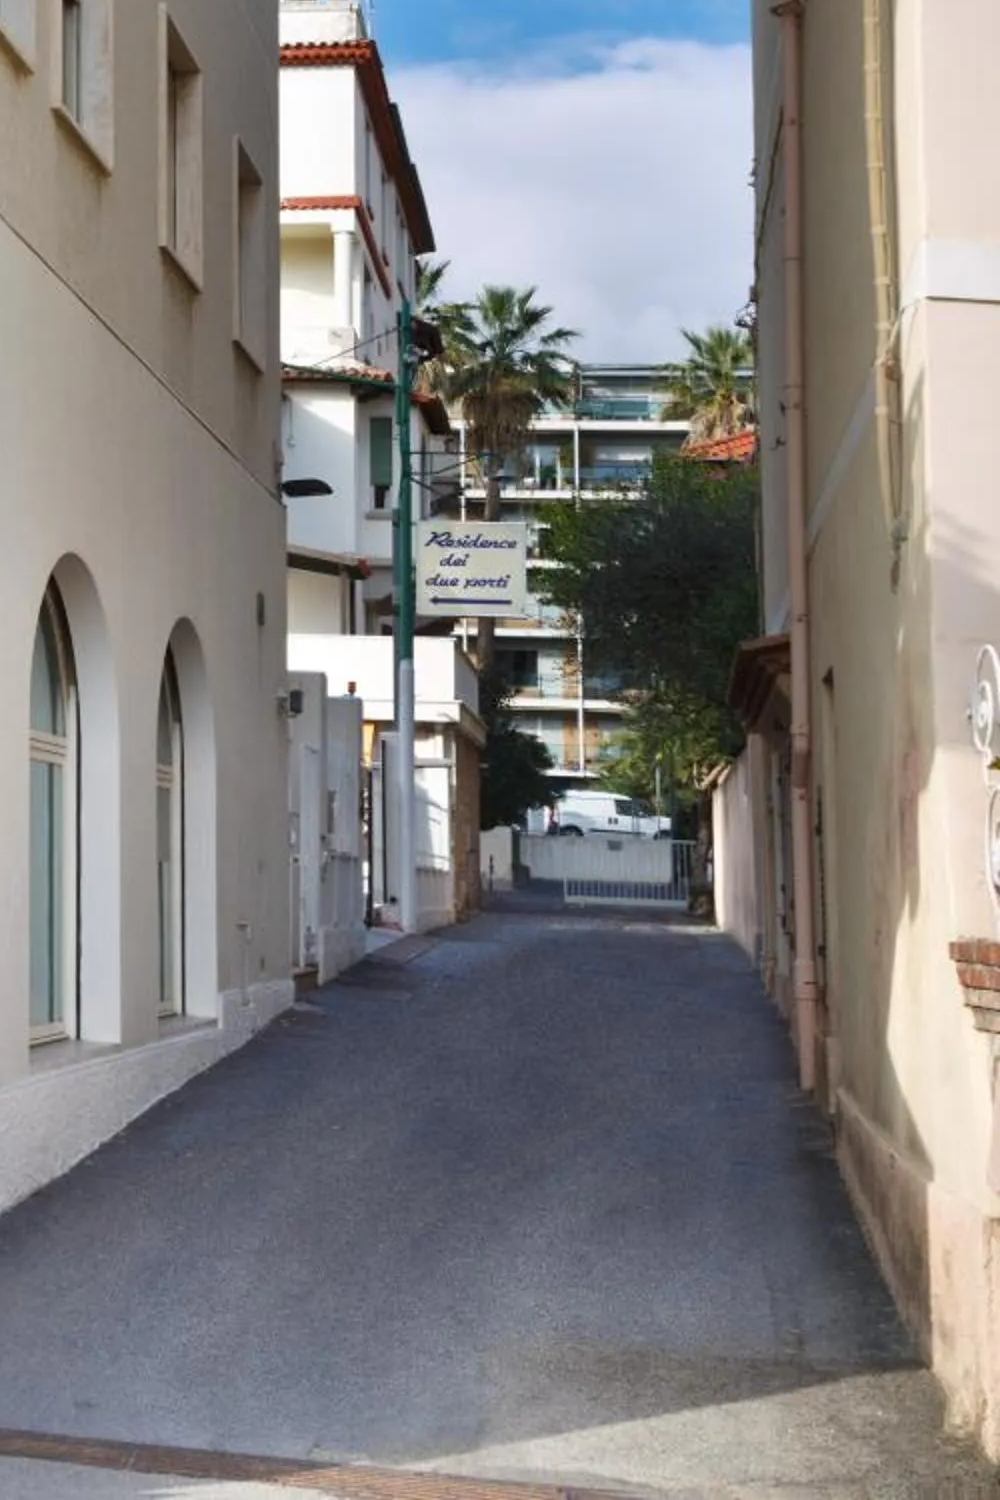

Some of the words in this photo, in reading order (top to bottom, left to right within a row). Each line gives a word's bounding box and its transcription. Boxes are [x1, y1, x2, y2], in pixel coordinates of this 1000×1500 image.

[424, 531, 518, 549] Residence
[439, 553, 470, 567] dei
[425, 573, 460, 587] due
[463, 574, 511, 589] porti
